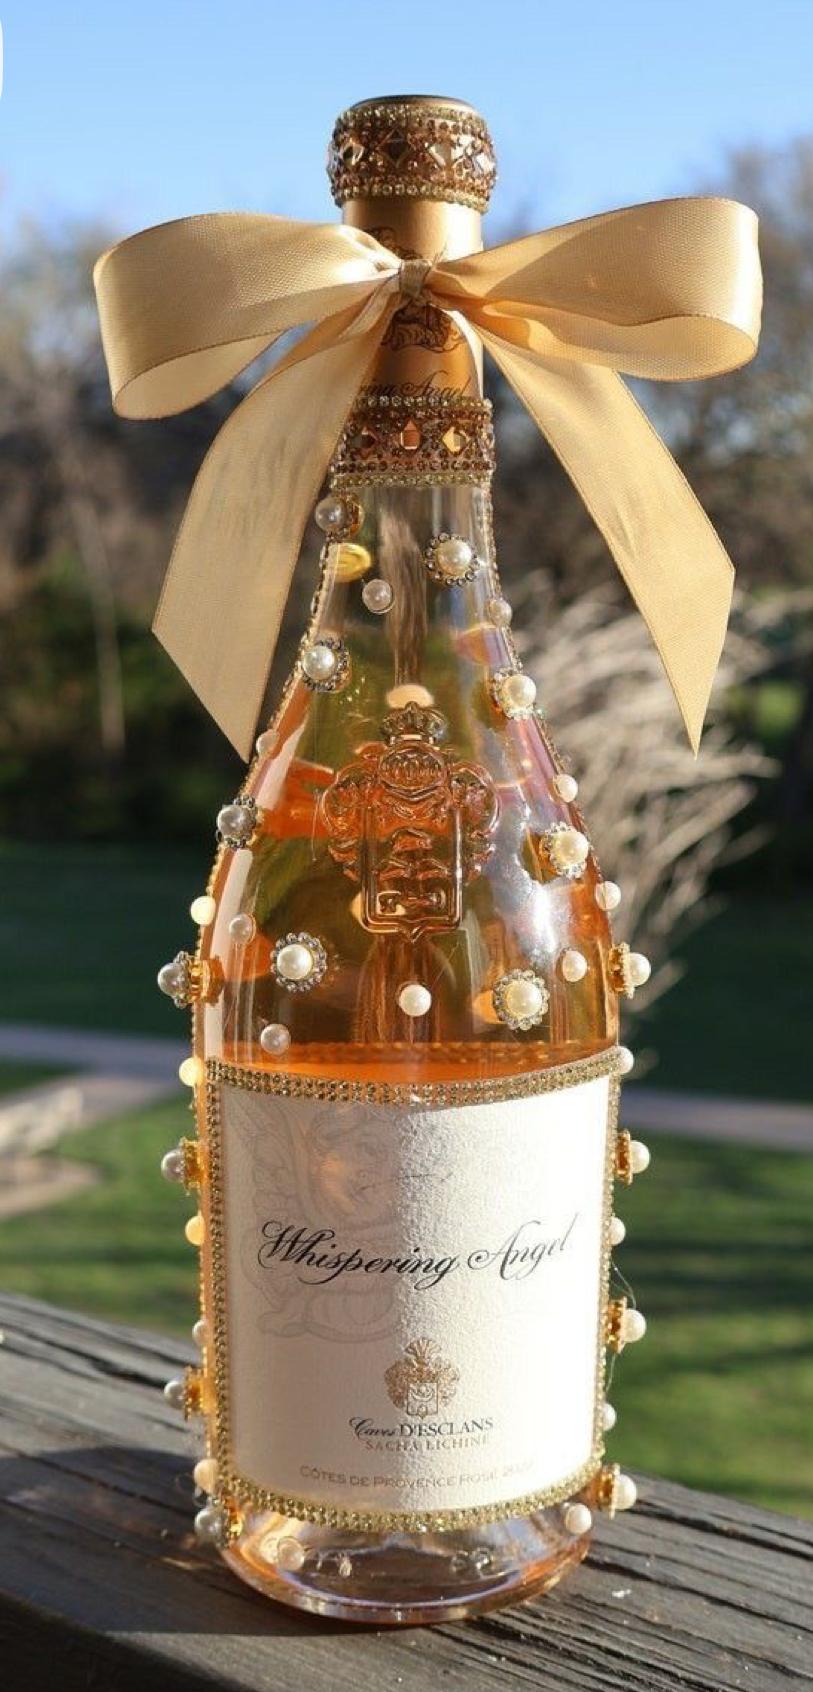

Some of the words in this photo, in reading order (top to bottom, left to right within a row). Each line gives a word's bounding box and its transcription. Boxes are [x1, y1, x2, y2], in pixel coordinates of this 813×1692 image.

[257, 1220, 459, 1291] Whispering
[467, 1212, 579, 1281] Angel
[349, 1416, 396, 1440] Caves
[399, 1416, 494, 1437] D'ESCLANS
[365, 1439, 419, 1452] SACHA
[350, 1476, 370, 1487] DE
[373, 1475, 458, 1489] PROVENCE
